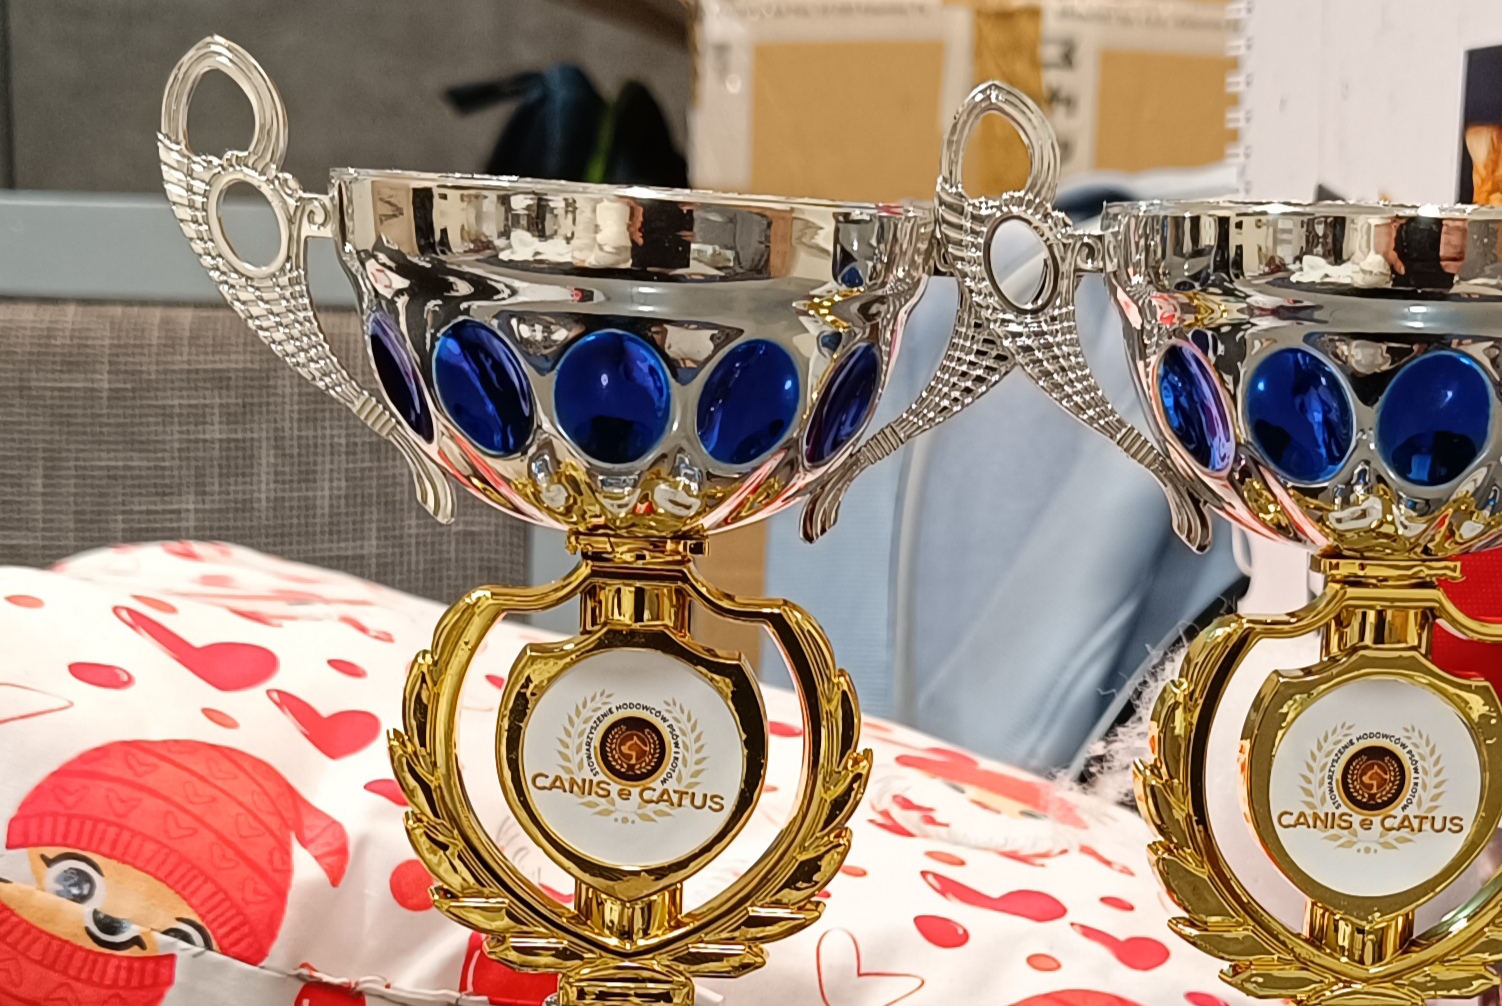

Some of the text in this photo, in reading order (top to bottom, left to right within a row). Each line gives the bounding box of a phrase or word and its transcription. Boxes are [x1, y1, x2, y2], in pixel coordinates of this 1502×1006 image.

[585, 707, 614, 777] STOWARZYSZENIE
[615, 702, 669, 723] HODOWCÓW
[667, 723, 680, 749] PSÓW
[1356, 732, 1408, 750] HODOWCÓW
[531, 772, 725, 813] CANIS e CATUS
[1277, 811, 1464, 833] CANIS e CATUS
